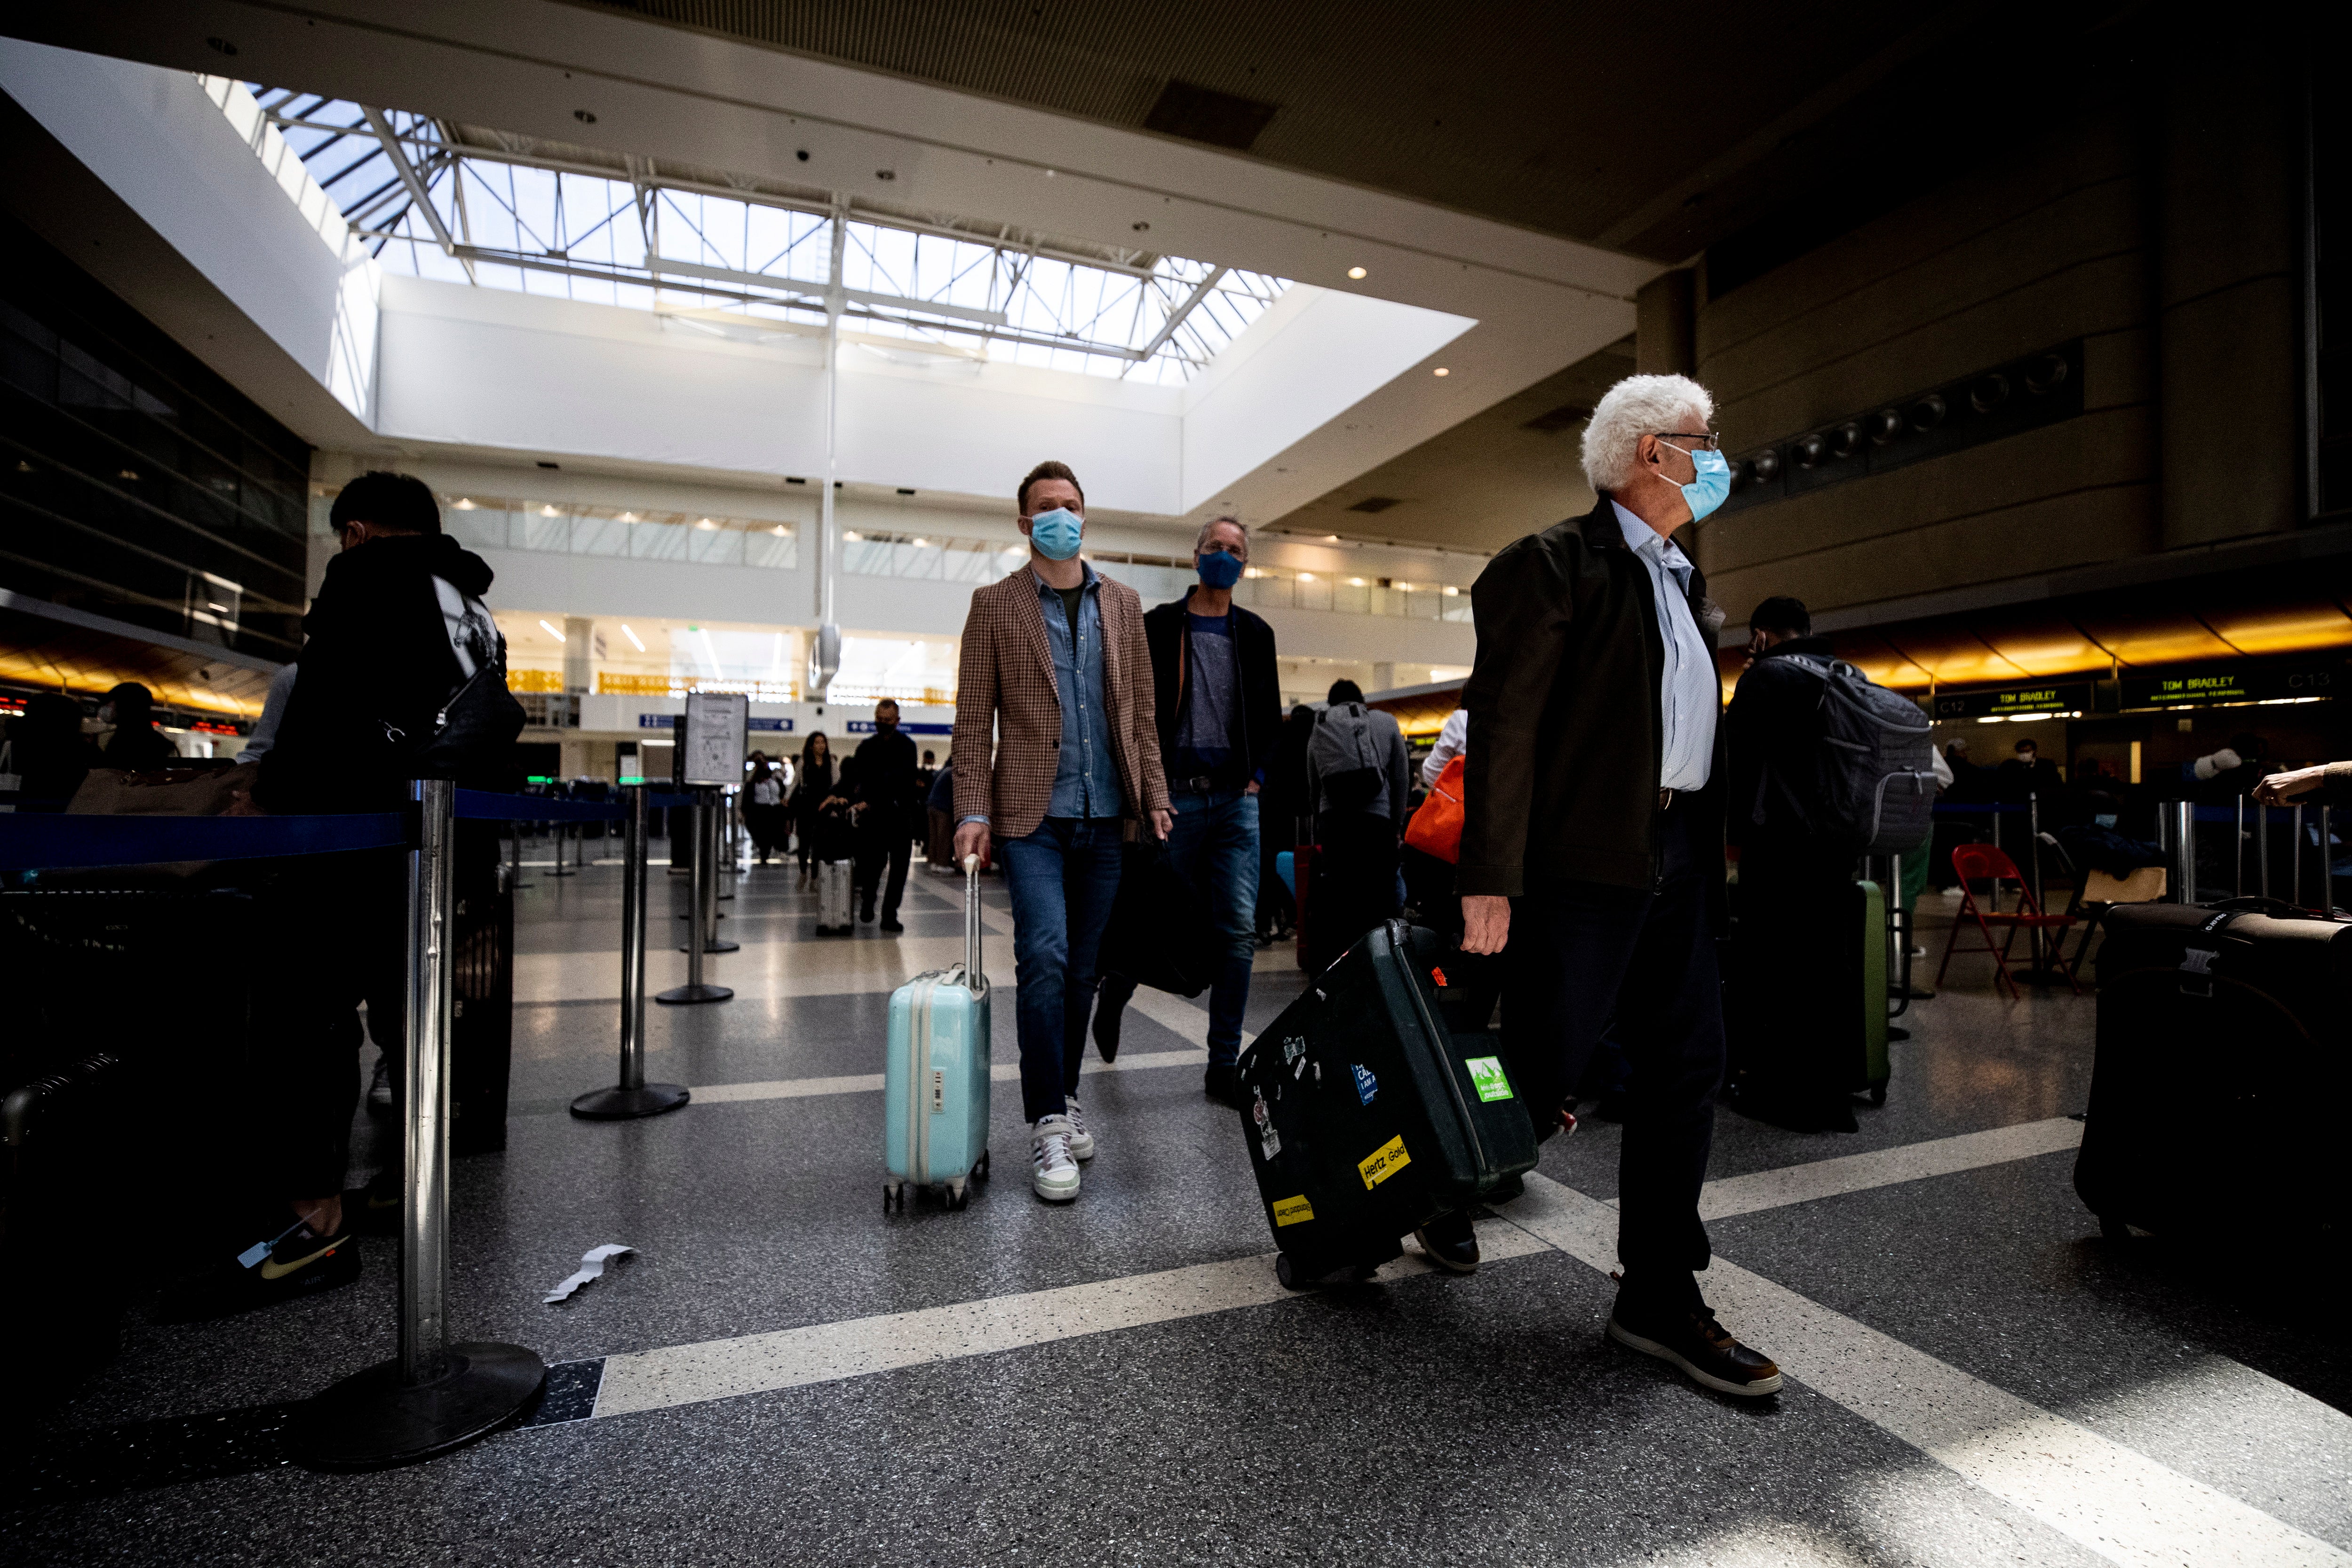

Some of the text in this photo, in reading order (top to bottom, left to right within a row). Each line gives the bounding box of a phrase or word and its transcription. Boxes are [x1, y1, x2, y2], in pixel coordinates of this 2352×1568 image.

[2161, 676, 2235, 691] TOM BRADLEY
[2288, 672, 2329, 689] C13
[2000, 690, 2056, 704] TOM BRADLEY
[1939, 700, 1965, 714] C12
[1364, 1077, 1372, 1088] AM
[1364, 1143, 1405, 1178] Hertz Gold
